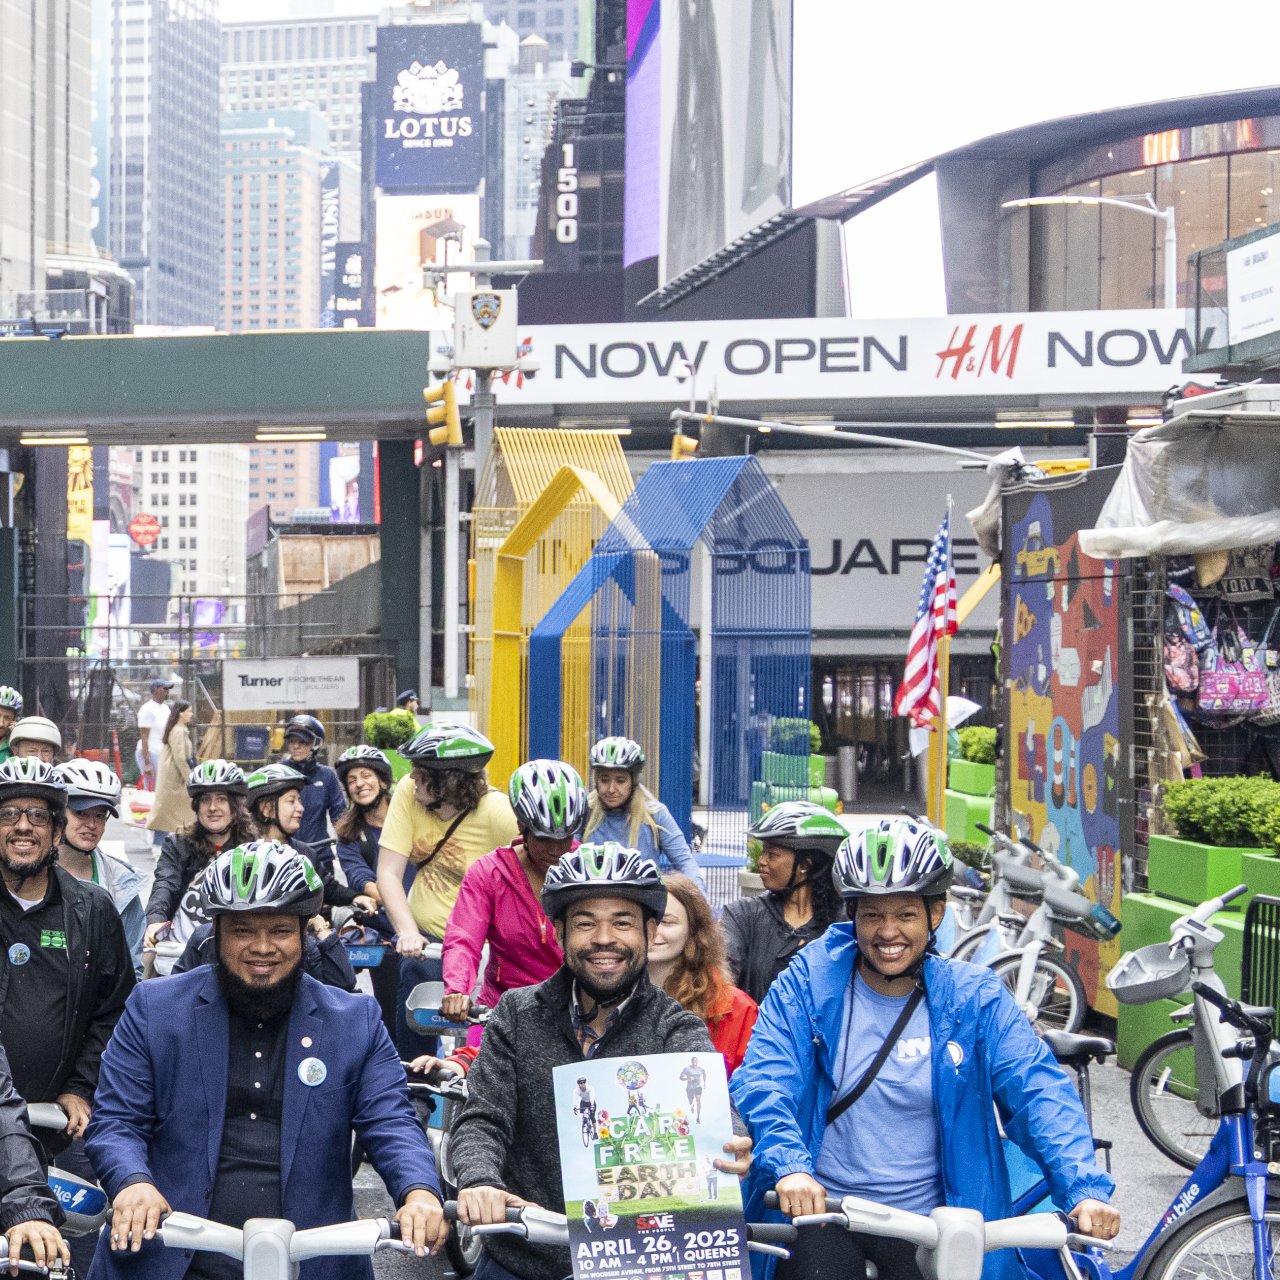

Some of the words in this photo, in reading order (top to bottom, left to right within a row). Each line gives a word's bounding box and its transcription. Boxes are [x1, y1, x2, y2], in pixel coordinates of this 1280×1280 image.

[384, 117, 473, 138] LOTUS
[556, 143, 578, 244] 1500
[555, 340, 709, 379] NOW
[724, 335, 908, 376] OPEN
[936, 323, 1024, 381] H&M
[238, 674, 283, 687] Turner
[898, 1037, 931, 1058] NY
[609, 1116, 675, 1139] CAR
[600, 1138, 692, 1165] FREE
[597, 1162, 696, 1184] EARTH
[618, 1180, 677, 1200] DAY
[1173, 1183, 1200, 1216] bike
[635, 1215, 675, 1230] SAVE
[576, 1239, 636, 1259] APRIL
[643, 1235, 677, 1253] 26,
[684, 1229, 739, 1249] 2025
[578, 1260, 594, 1271] 10
[599, 1257, 621, 1268] AM
[637, 1256, 646, 1265] 4
[651, 1253, 672, 1263] PM
[684, 1246, 740, 1261] QUEENS
[722, 1259, 741, 1267] STREET
